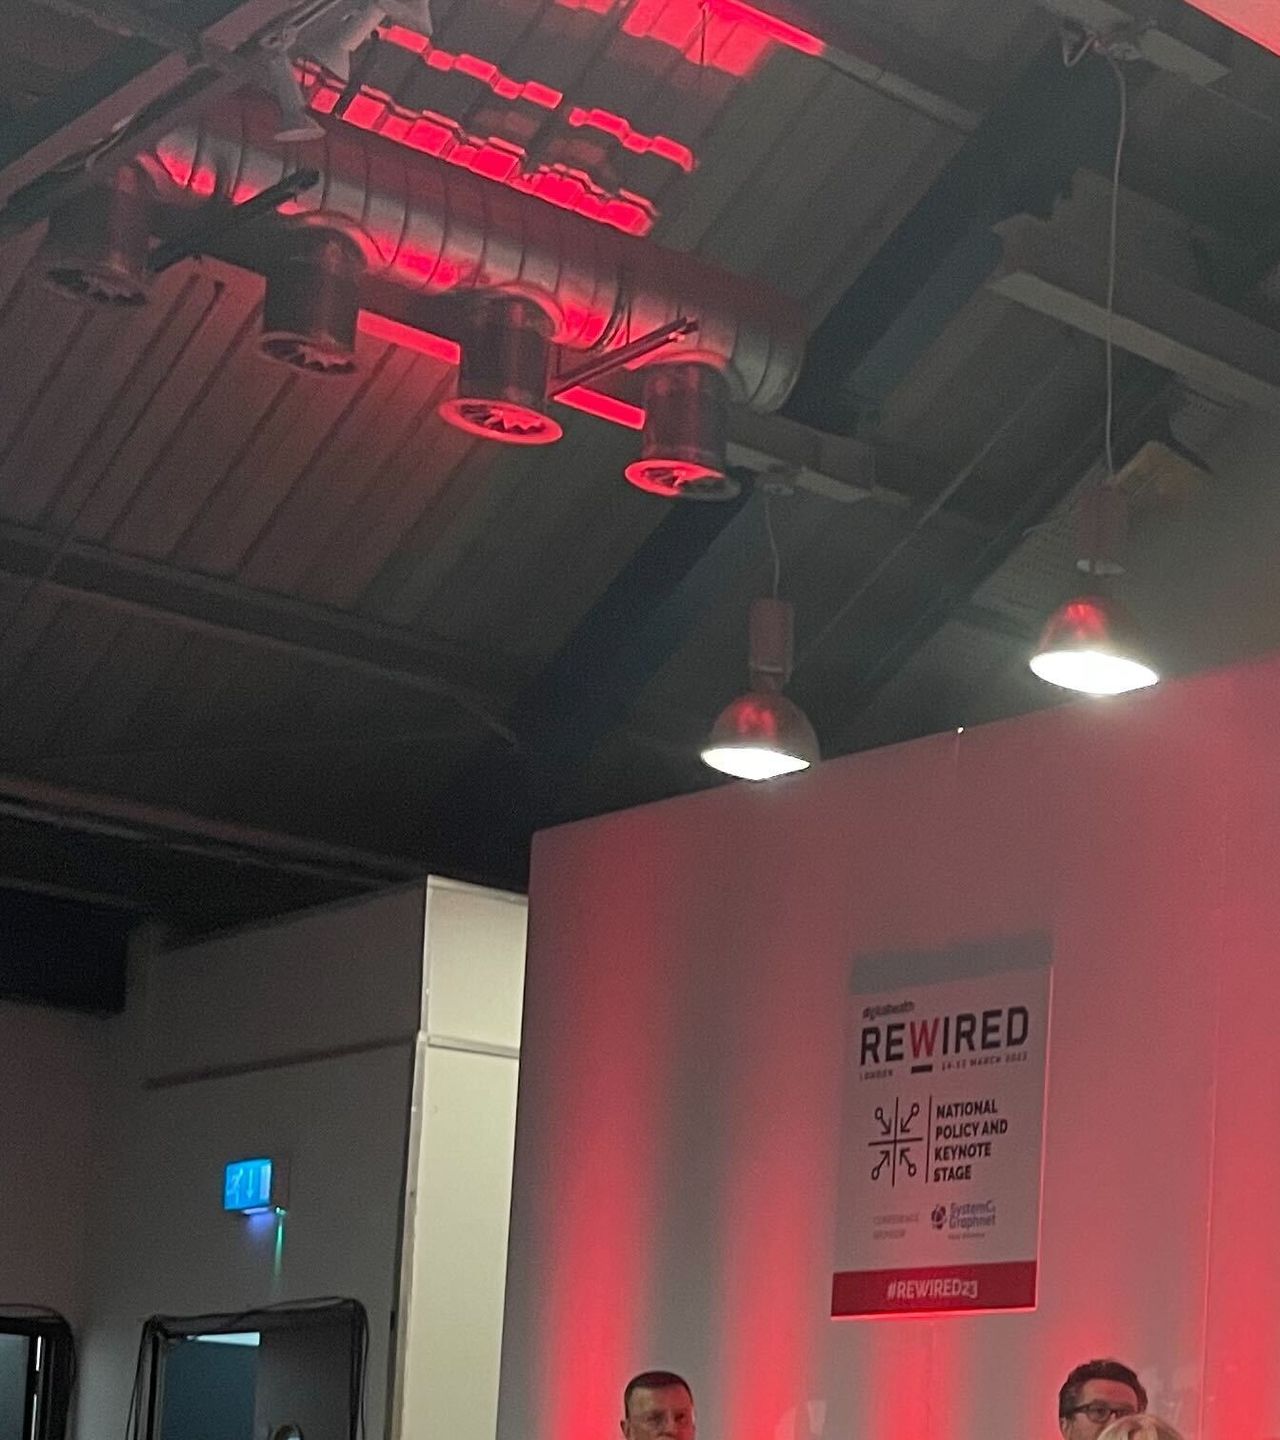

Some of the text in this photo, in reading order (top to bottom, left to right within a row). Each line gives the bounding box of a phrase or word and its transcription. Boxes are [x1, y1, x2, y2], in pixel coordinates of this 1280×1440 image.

[860, 1006, 1029, 1066] REWIRED
[936, 1099, 998, 1119] NATIONAL
[936, 1118, 1008, 1141] POLICY AND
[934, 1142, 992, 1161] KEYNOTE
[933, 1165, 972, 1182] STAGE
[887, 1279, 979, 1300] #REWIRED23
